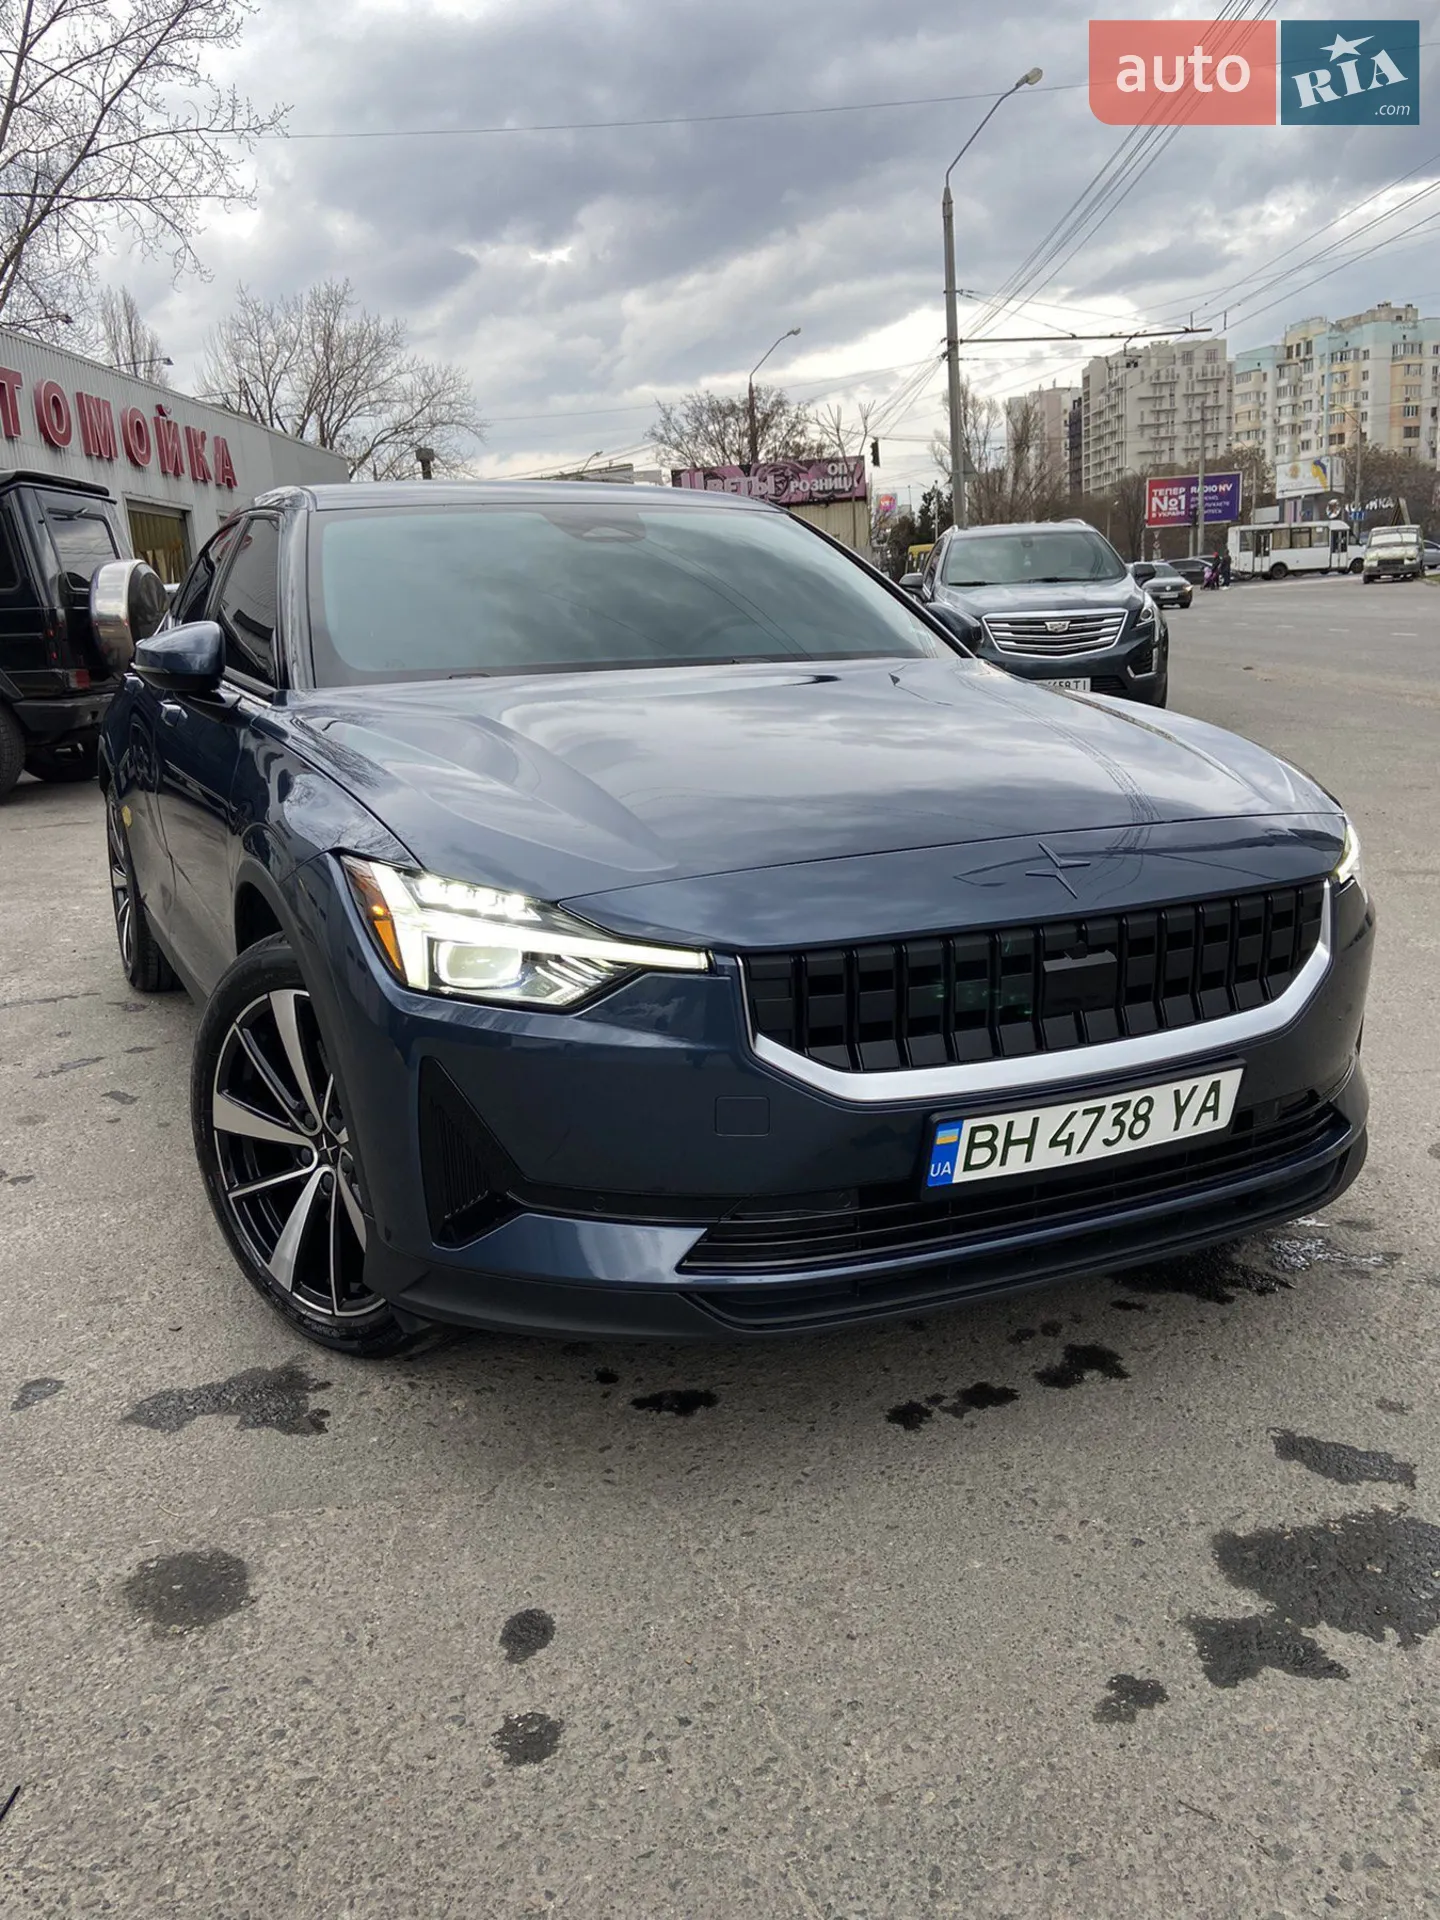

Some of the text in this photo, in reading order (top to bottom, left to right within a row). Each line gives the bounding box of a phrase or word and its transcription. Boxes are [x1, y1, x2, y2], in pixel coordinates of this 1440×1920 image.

[828, 462, 857, 476] ОПТ
[1152, 487, 1186, 496] ТЕПЕР
[1048, 1095, 1155, 1157] 4738
[1173, 1079, 1222, 1132] YA
[930, 1163, 952, 1178] UA
